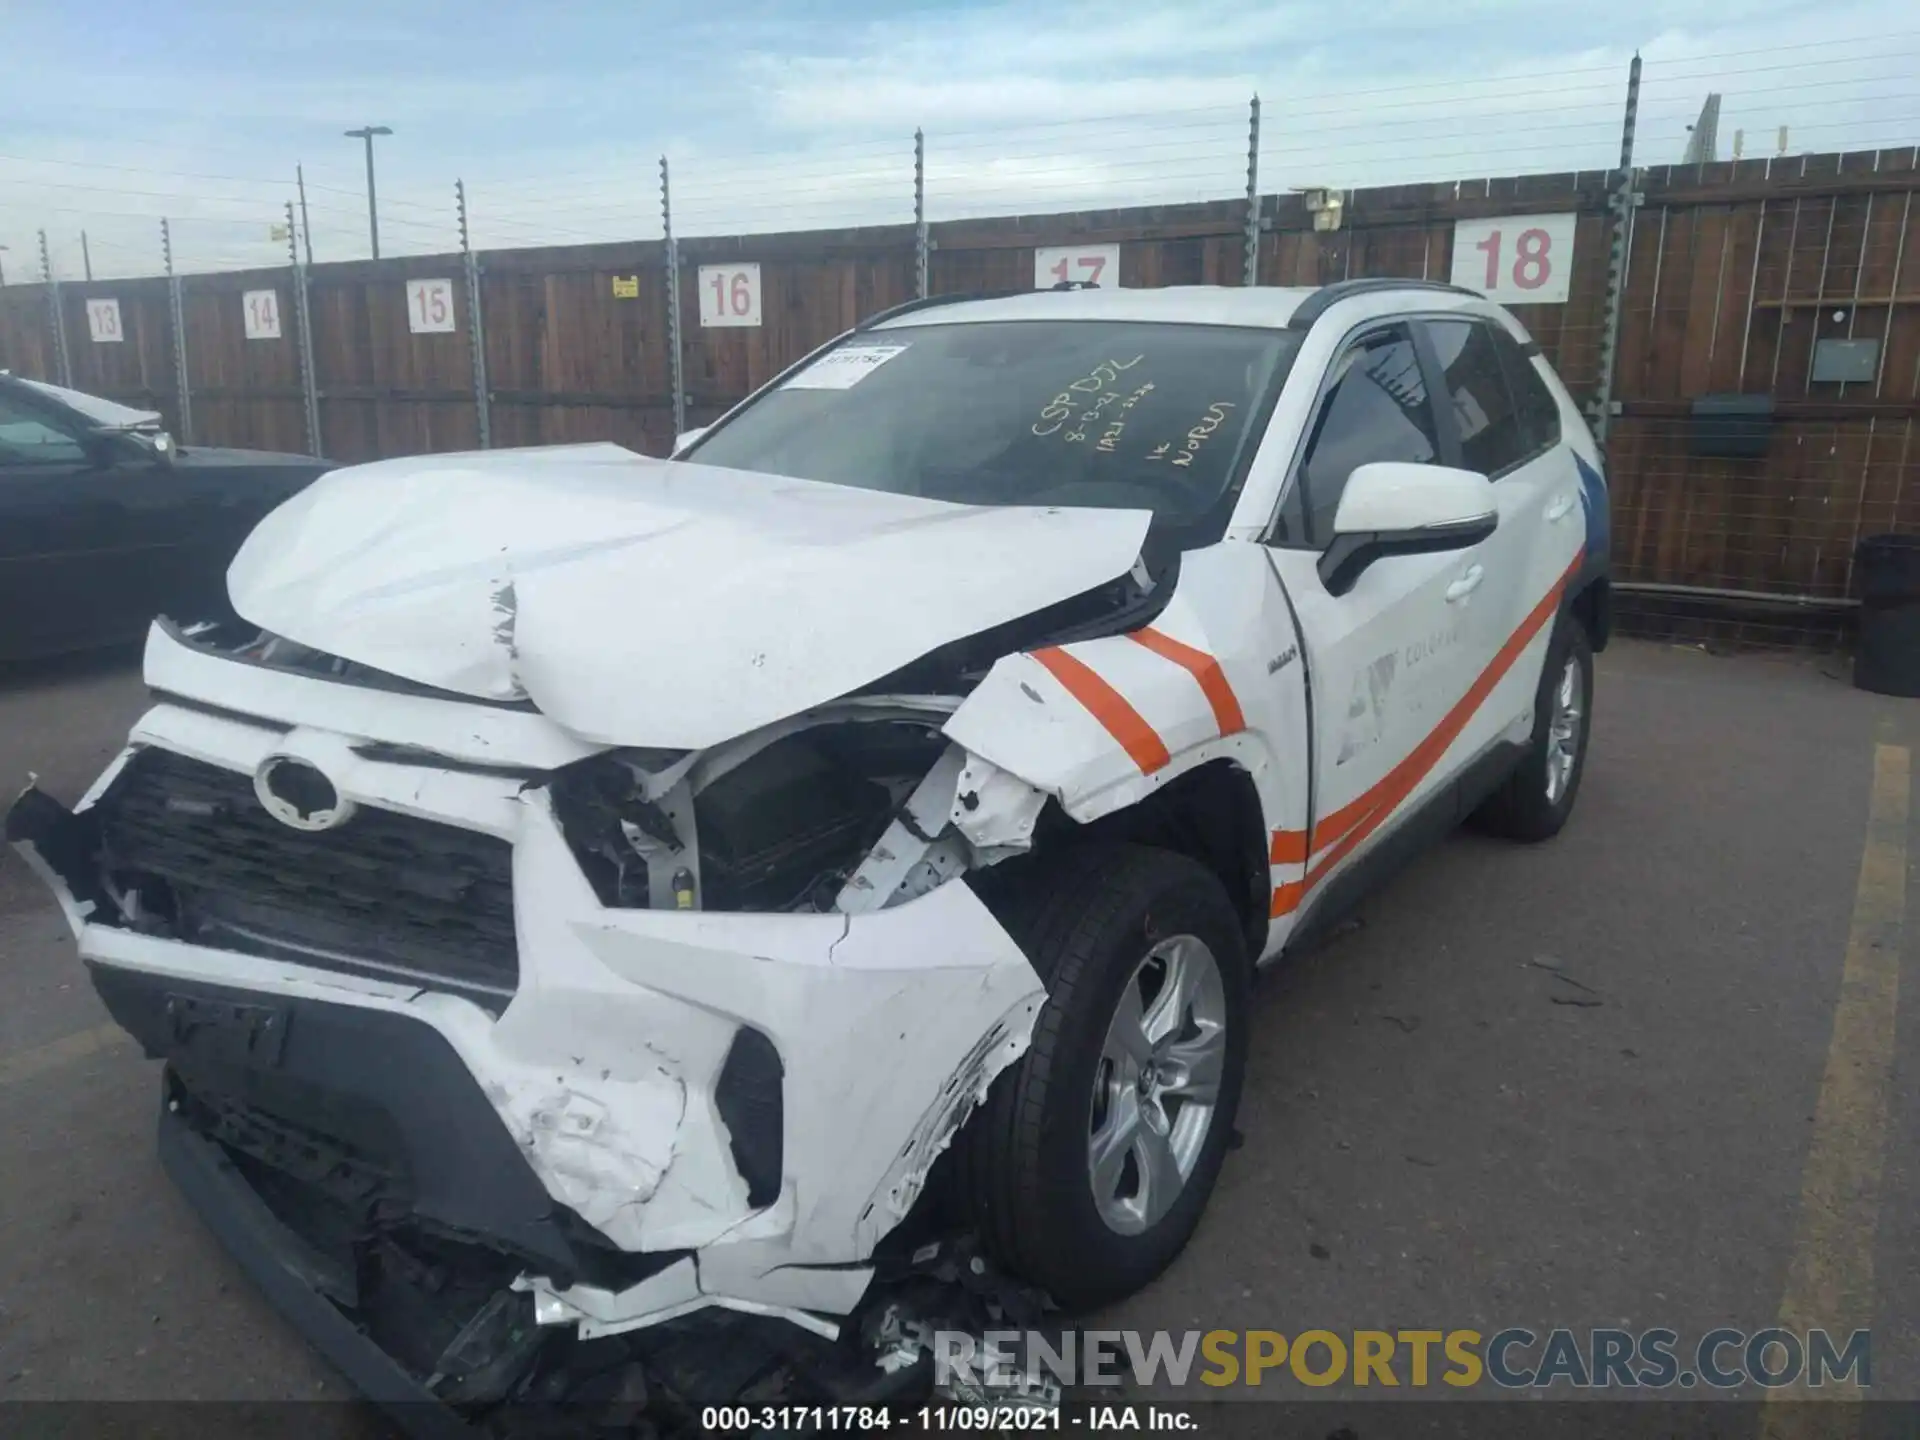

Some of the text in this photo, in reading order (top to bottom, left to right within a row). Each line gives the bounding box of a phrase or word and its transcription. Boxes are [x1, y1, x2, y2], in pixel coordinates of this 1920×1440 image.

[1050, 255, 1106, 283] 17
[1475, 227, 1552, 291] 18
[414, 285, 447, 325] 15
[711, 272, 750, 316] 16
[93, 304, 116, 335] 13
[249, 296, 276, 331] 14
